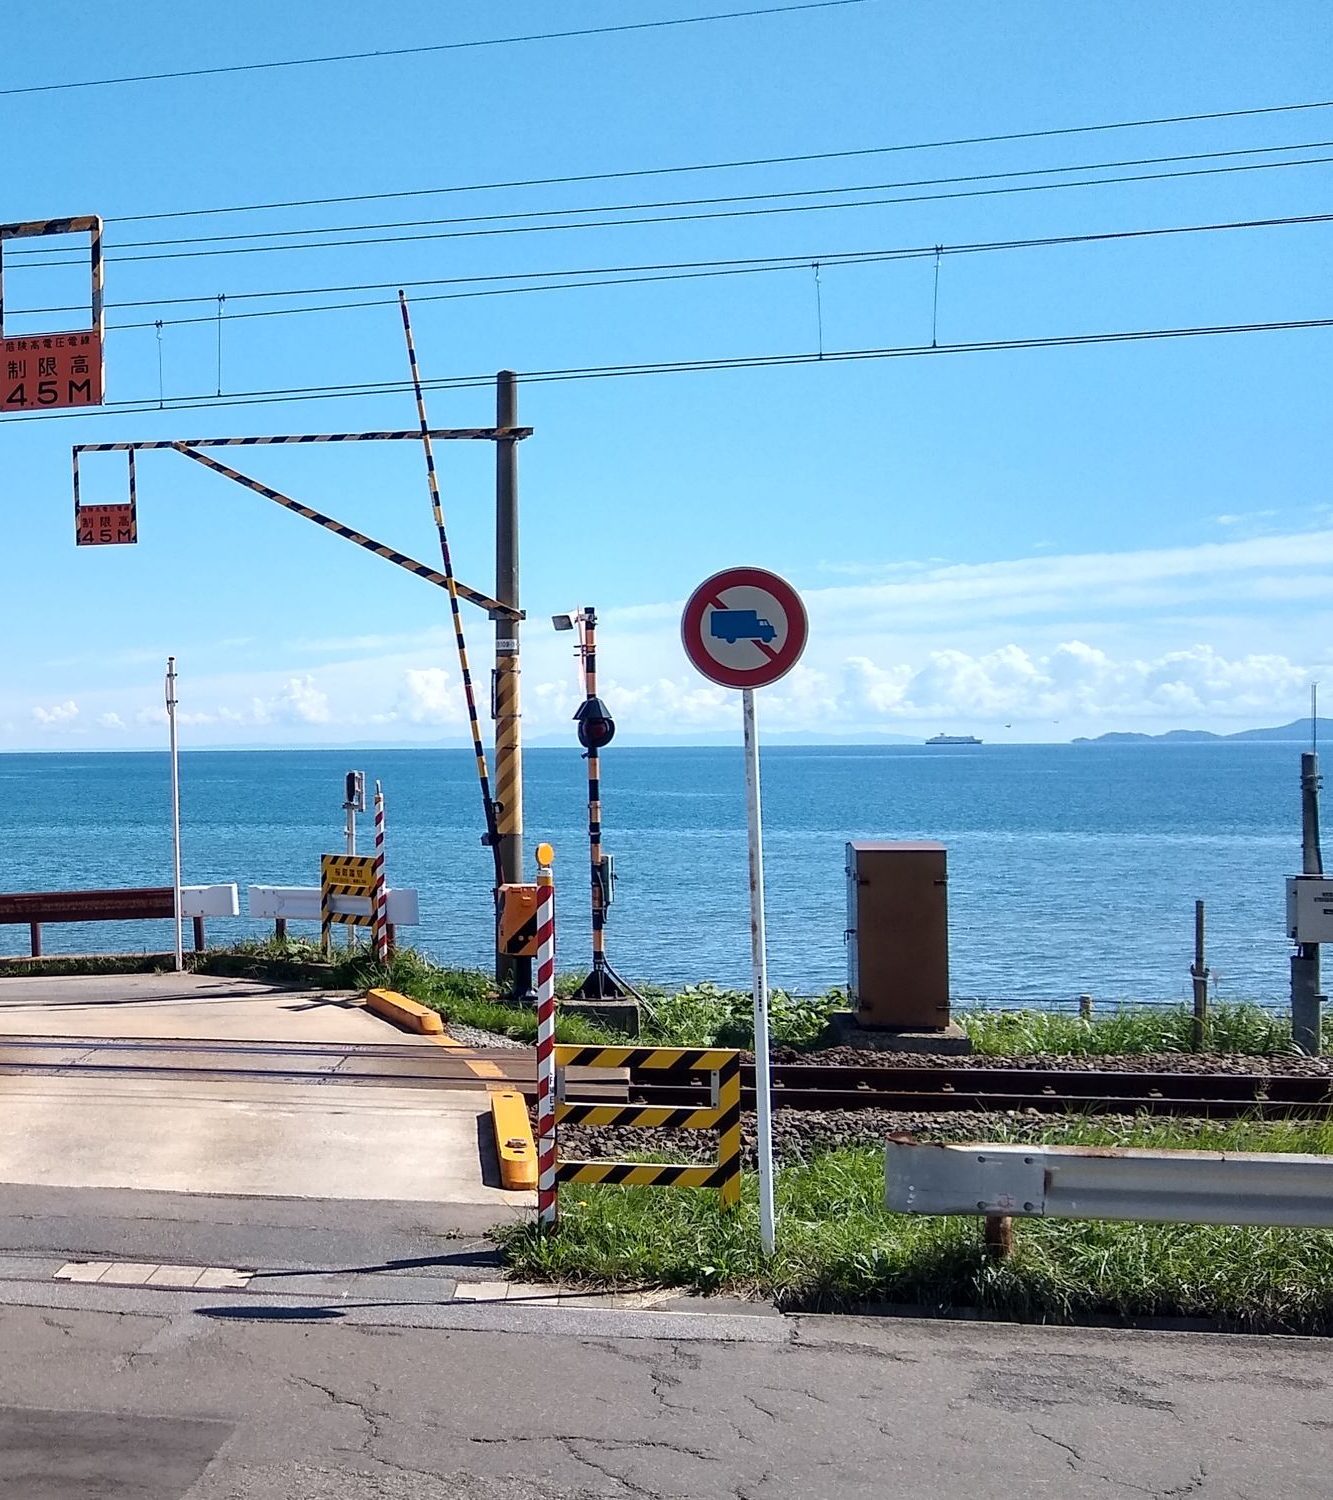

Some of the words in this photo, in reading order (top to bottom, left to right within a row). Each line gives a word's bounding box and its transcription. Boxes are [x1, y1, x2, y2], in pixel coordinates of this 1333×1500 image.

[7, 355, 89, 379] 制限高
[6, 379, 91, 406] 4.5M
